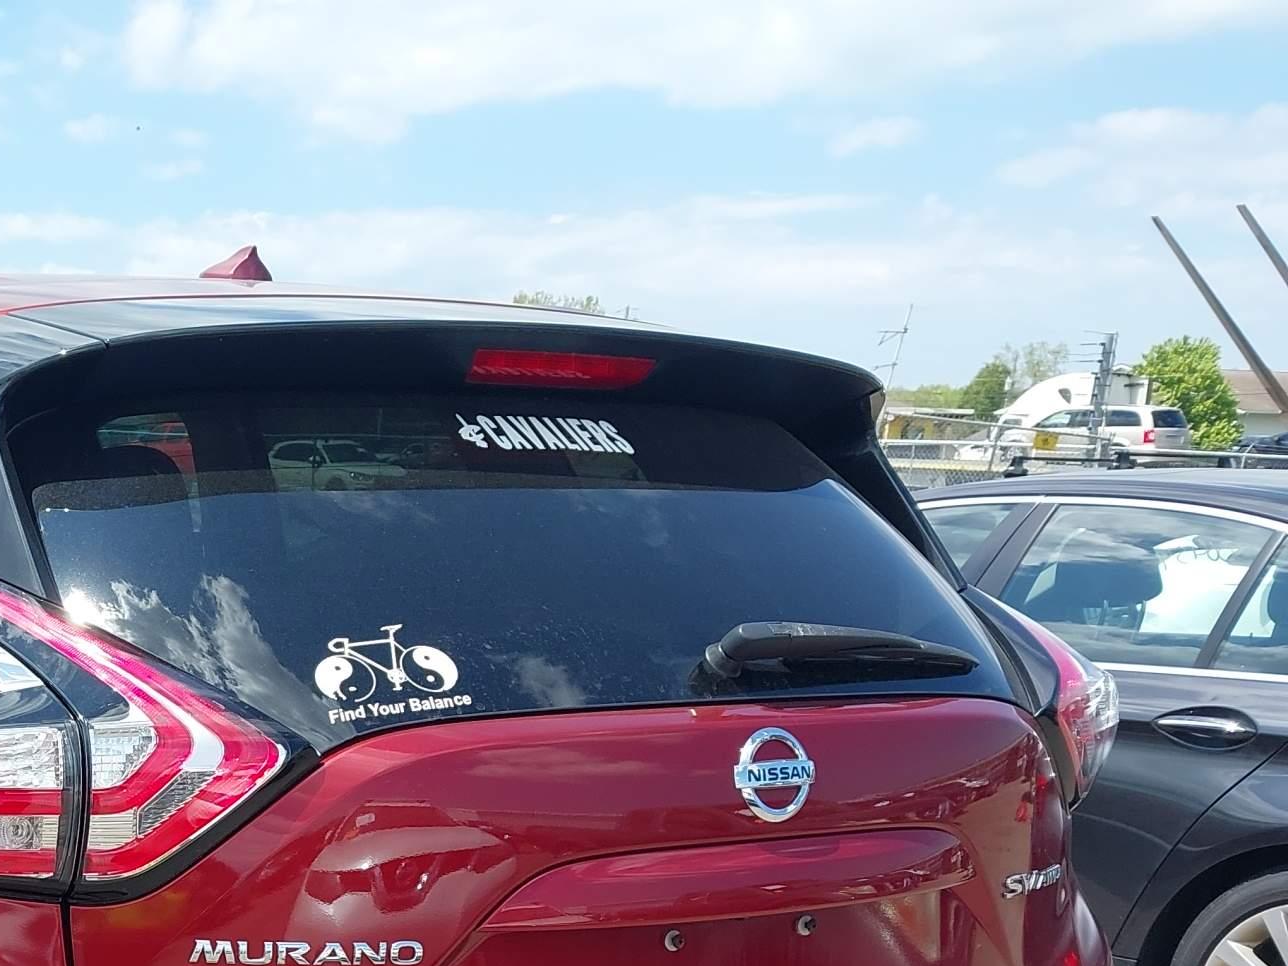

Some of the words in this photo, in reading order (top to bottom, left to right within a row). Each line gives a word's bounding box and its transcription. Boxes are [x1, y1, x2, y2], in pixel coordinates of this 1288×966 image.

[475, 415, 635, 455] CAVALIERS
[328, 705, 367, 725] Find
[368, 701, 407, 717] Your
[409, 694, 473, 712] Balance
[747, 765, 811, 783] NISSAN
[188, 939, 424, 966] MURANO
